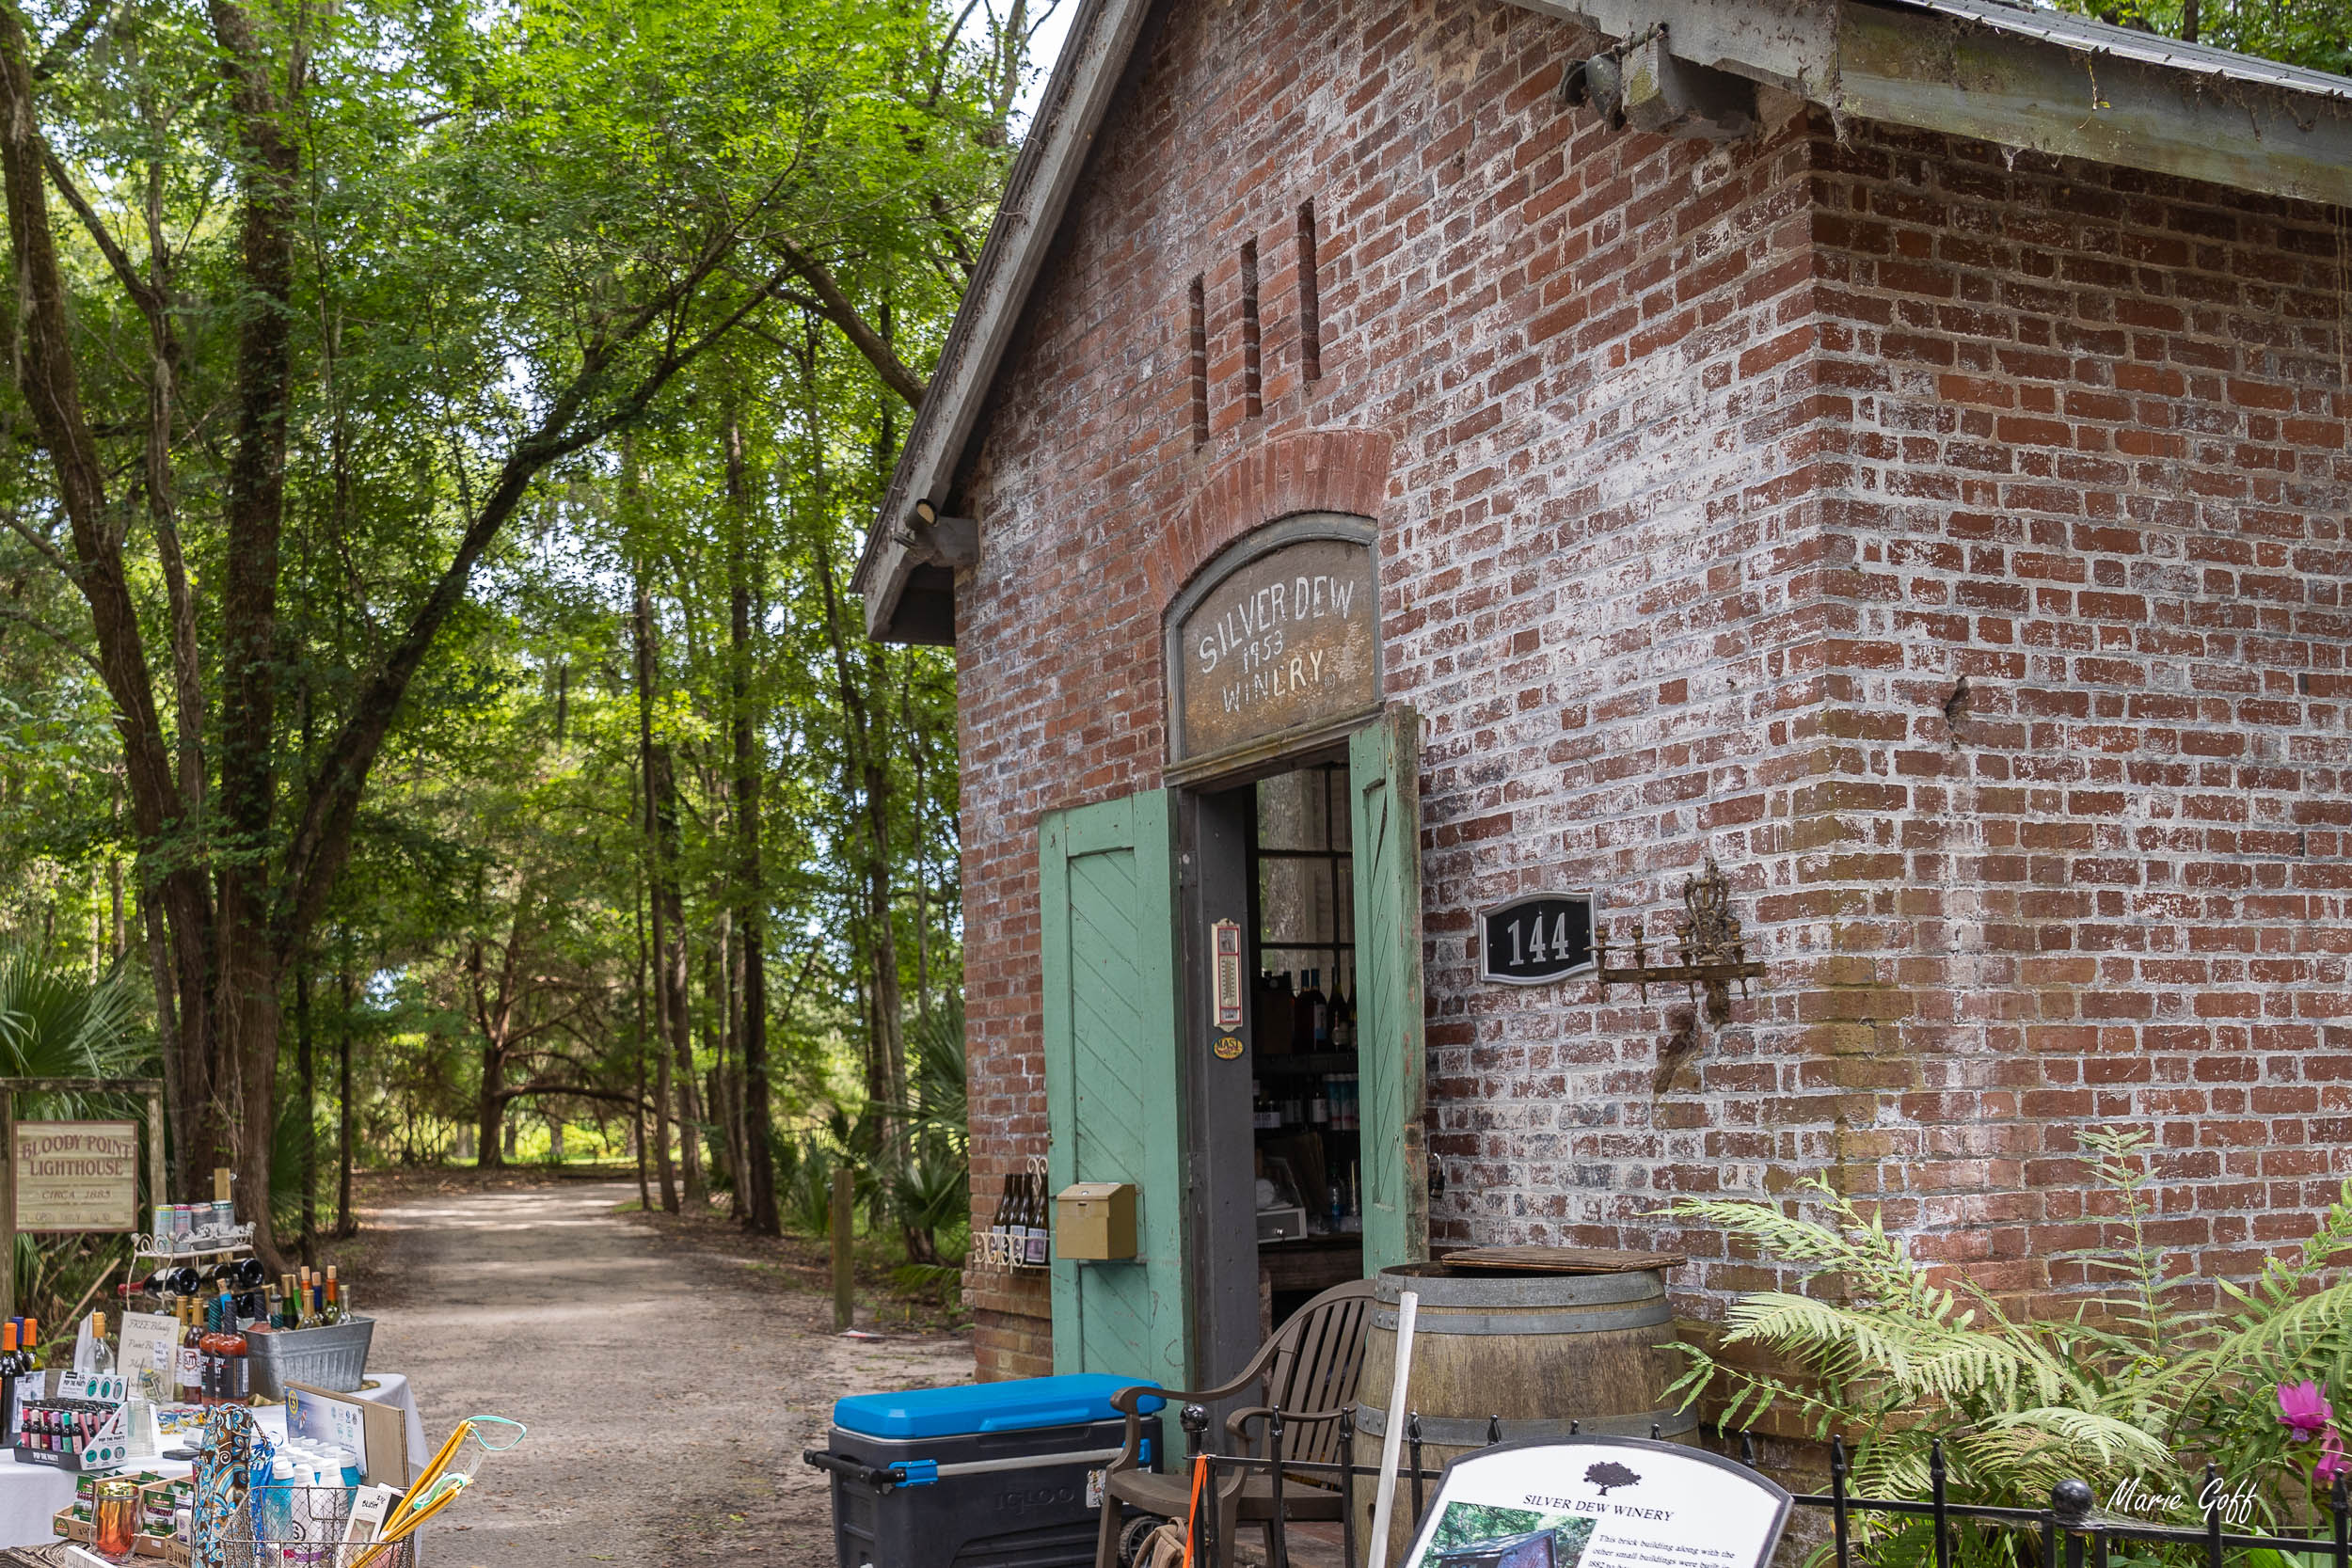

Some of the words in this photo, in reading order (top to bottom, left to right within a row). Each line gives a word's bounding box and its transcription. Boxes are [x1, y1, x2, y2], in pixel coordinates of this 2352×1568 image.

[1199, 582, 1287, 673] SILVER
[1295, 576, 1354, 619] DEW
[1243, 630, 1283, 673] 1953
[1223, 650, 1324, 713] WINERY
[1507, 911, 1569, 966] 144
[22, 1134, 83, 1160] BLOODY
[87, 1135, 133, 1160] POINT
[30, 1160, 123, 1177] LIGHTHOUSE
[41, 1190, 76, 1200] CIRCA
[1523, 1494, 1572, 1510] SILVER
[1575, 1499, 1610, 1513] DEW
[1614, 1504, 1674, 1522] WINERY
[1593, 1548, 1613, 1557] other
[1639, 1553, 1677, 1566] buildings
[1599, 1534, 1616, 1543] This
[1618, 1537, 1638, 1546] brick
[1640, 1540, 1674, 1552] building
[1676, 1545, 1699, 1555] along
[1701, 1548, 1719, 1557] with
[1721, 1550, 1735, 1559] the
